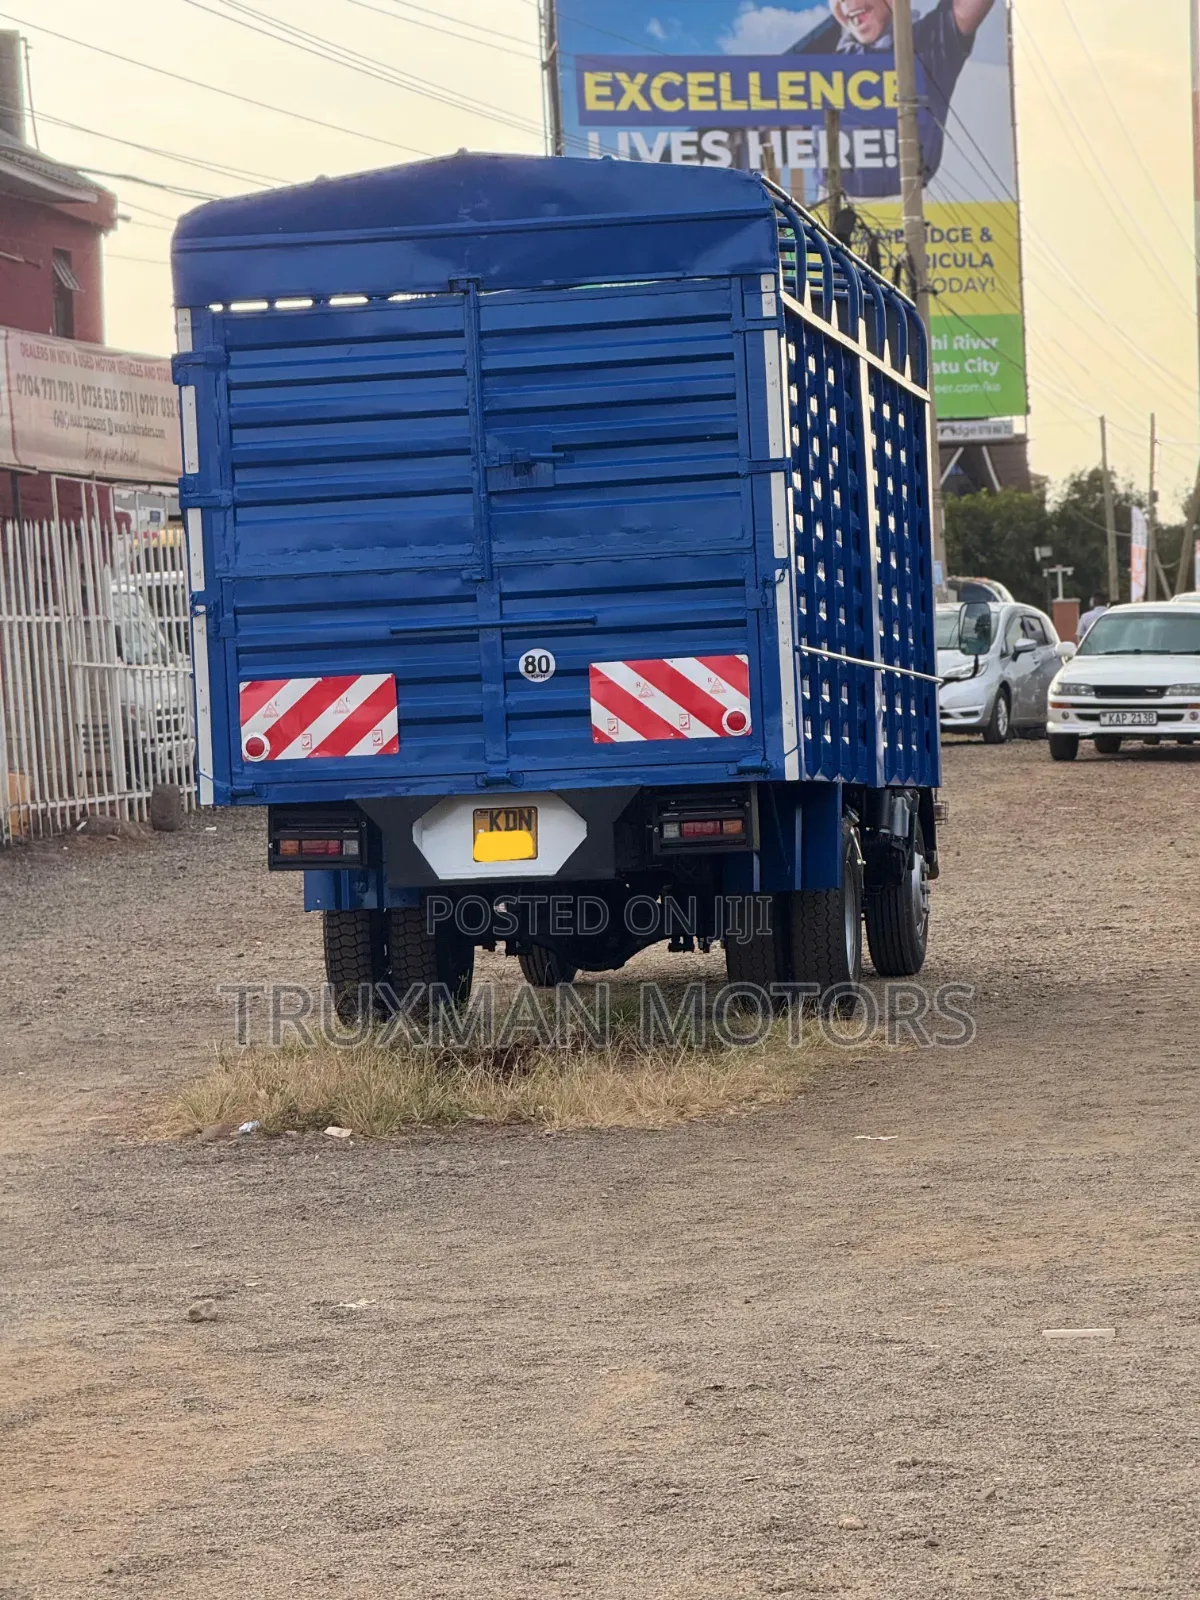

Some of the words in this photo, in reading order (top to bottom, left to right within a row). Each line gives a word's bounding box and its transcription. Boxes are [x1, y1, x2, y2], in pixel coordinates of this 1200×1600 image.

[583, 70, 899, 112] EXCELLENCE
[587, 130, 733, 168] LIVES
[747, 129, 898, 169] HERE!
[980, 226, 993, 242] &
[953, 333, 999, 350] River
[964, 356, 1000, 376] City
[16, 373, 40, 398] 0704
[524, 654, 550, 674] 80
[1109, 713, 1127, 724] KAP
[489, 809, 532, 832] KDN
